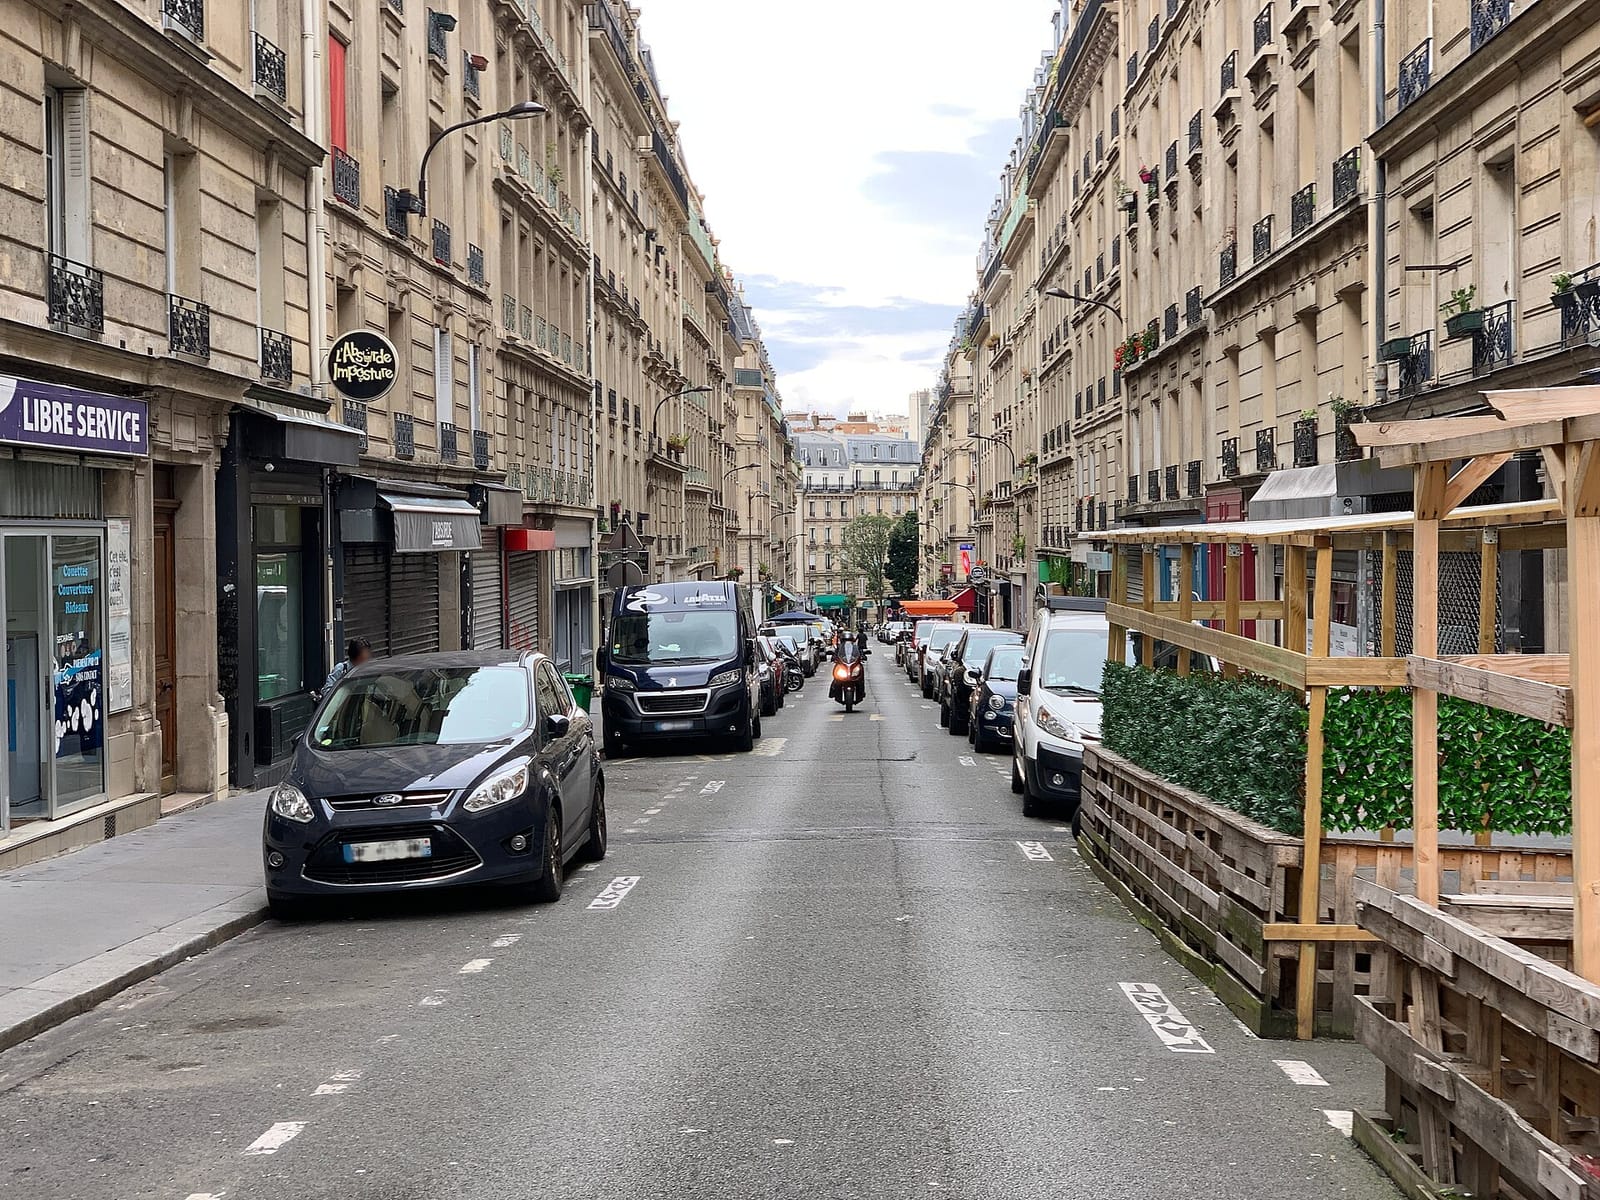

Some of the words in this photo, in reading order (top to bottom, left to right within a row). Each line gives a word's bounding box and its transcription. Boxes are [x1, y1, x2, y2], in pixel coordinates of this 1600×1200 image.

[336, 341, 392, 365] L'Absurde
[333, 363, 393, 382] Imposture
[23, 397, 73, 435] LIBRE
[76, 404, 140, 442] SERVICE
[63, 565, 88, 577] Couettes
[58, 584, 94, 596] Couvertures
[65, 602, 89, 614] Rideaux
